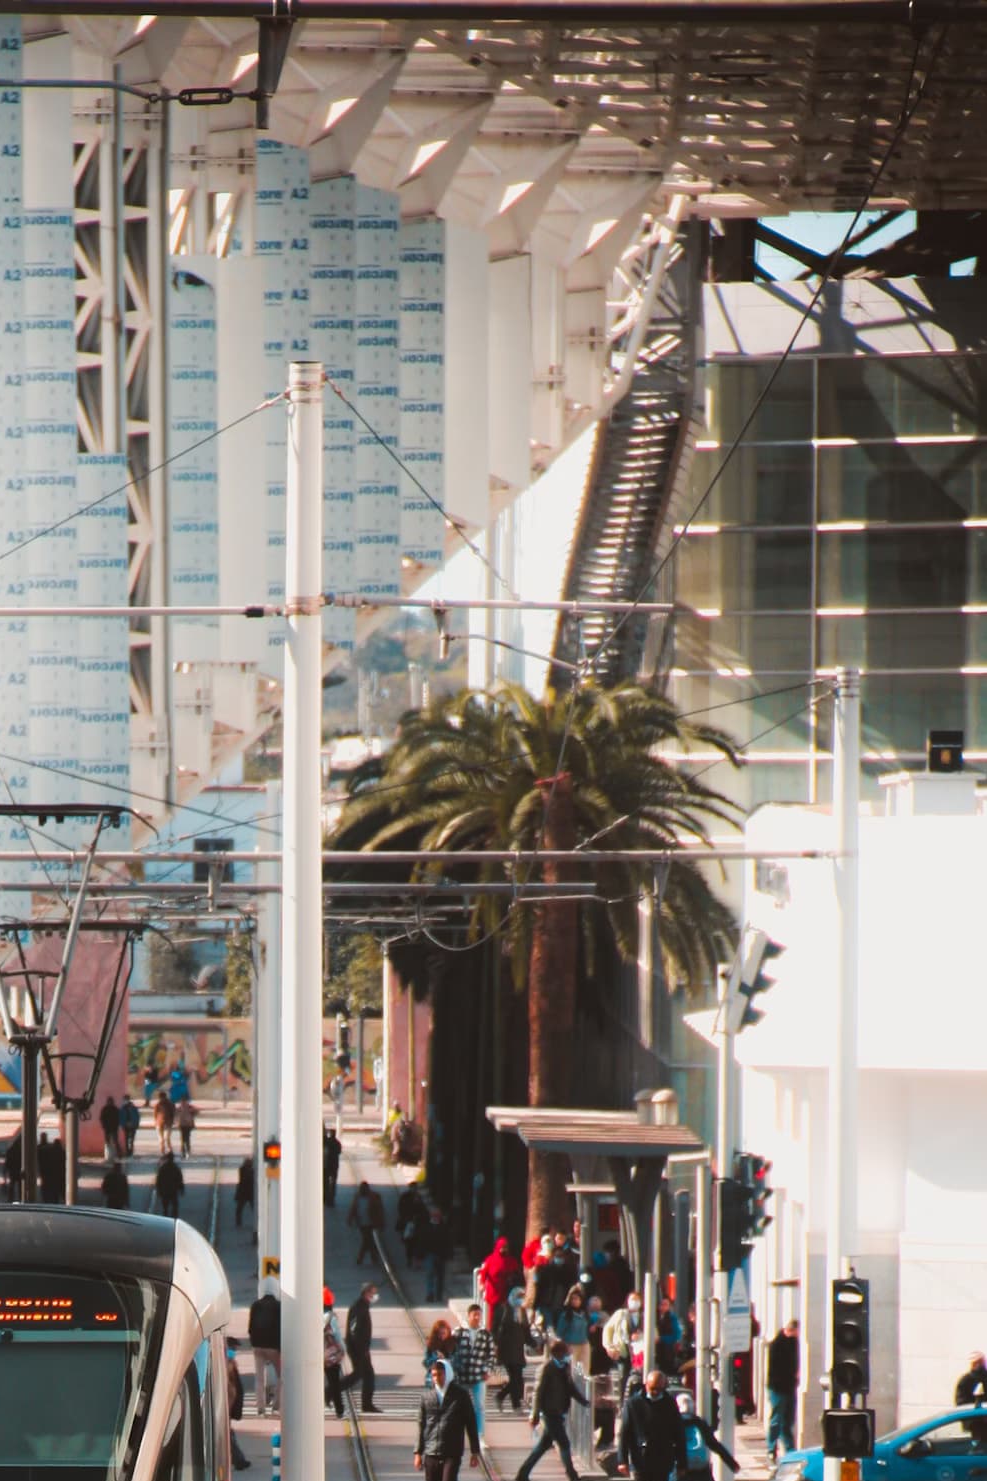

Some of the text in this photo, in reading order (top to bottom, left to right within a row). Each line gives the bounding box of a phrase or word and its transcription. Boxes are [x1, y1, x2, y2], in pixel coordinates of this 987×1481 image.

[1, 38, 19, 50] A2
[1, 92, 19, 103] A2
[2, 145, 20, 156] A2
[290, 188, 308, 199] A2
[4, 217, 21, 229] A2
[310, 220, 355, 230] larcor
[291, 239, 309, 250] A2
[4, 270, 21, 281] A2
[310, 270, 354, 281] larcor
[291, 290, 309, 300] A2
[400, 304, 443, 314] larcor
[4, 323, 22, 334] A2
[172, 320, 216, 331] larcor
[309, 320, 354, 331] larcor
[291, 340, 308, 350] A2
[400, 355, 443, 365] larcor
[5, 375, 21, 386] A2
[173, 371, 216, 382] larcor
[401, 404, 443, 414] larcor
[173, 422, 217, 432] larcor
[5, 428, 23, 439] A2
[400, 453, 442, 464] larcor
[173, 473, 217, 483] larcor
[6, 480, 23, 491] A2
[173, 523, 218, 533] larcor
[8, 532, 23, 543] A2
[173, 574, 218, 584] larcor
[8, 584, 24, 595] A2
[8, 621, 26, 632] A2
[9, 673, 26, 684] A2
[9, 726, 26, 736] A2
[10, 777, 27, 788] A2
